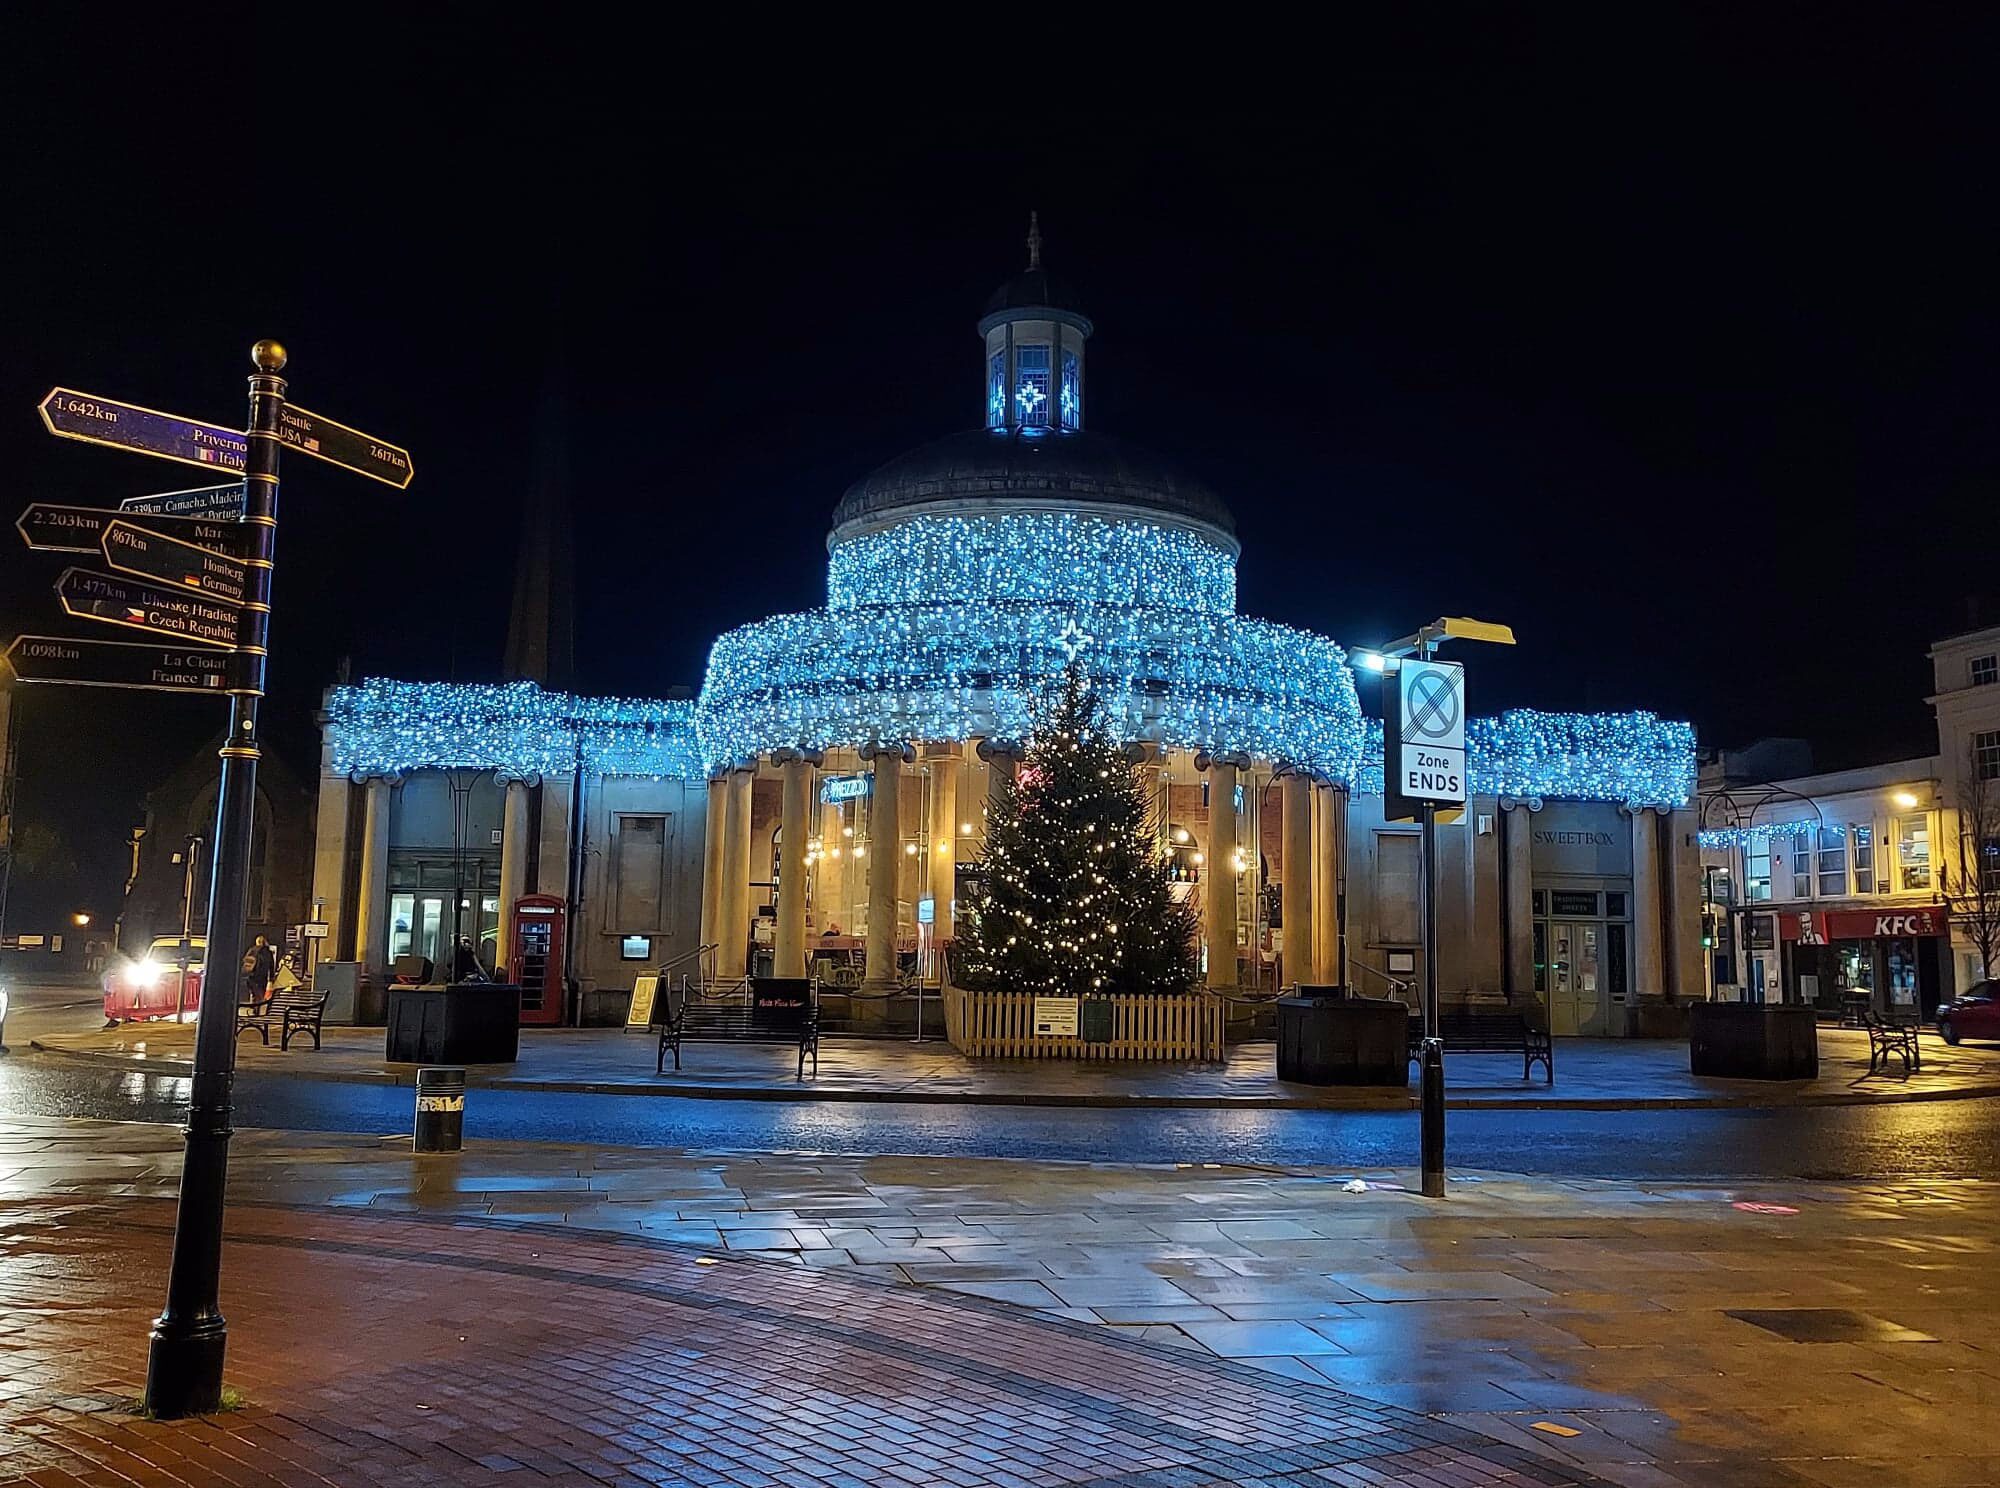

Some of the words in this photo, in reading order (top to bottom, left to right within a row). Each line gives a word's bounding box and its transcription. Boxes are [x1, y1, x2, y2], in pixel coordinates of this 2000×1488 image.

[55, 397, 118, 423] 1.642km
[281, 409, 312, 431] Seattle
[193, 429, 247, 453] Priverno
[280, 426, 302, 443] USA
[219, 451, 247, 469] Italy
[33, 511, 99, 529] 2.203km
[208, 509, 242, 520] Portuga
[112, 528, 147, 551] 867km
[203, 558, 244, 582] Homberg
[72, 576, 126, 600] 1.477km
[202, 575, 243, 598] Germany
[192, 603, 239, 624] Hradiste
[149, 611, 185, 630] Czech
[189, 619, 237, 640] Republic
[21, 643, 80, 660] 1.098km
[163, 653, 182, 667] La
[152, 669, 199, 684] France
[1417, 752, 1449, 769] Zone
[1409, 771, 1459, 792] ENDS
[1534, 831, 1615, 846] SWEETBOX
[1874, 915, 1918, 935] KFC
